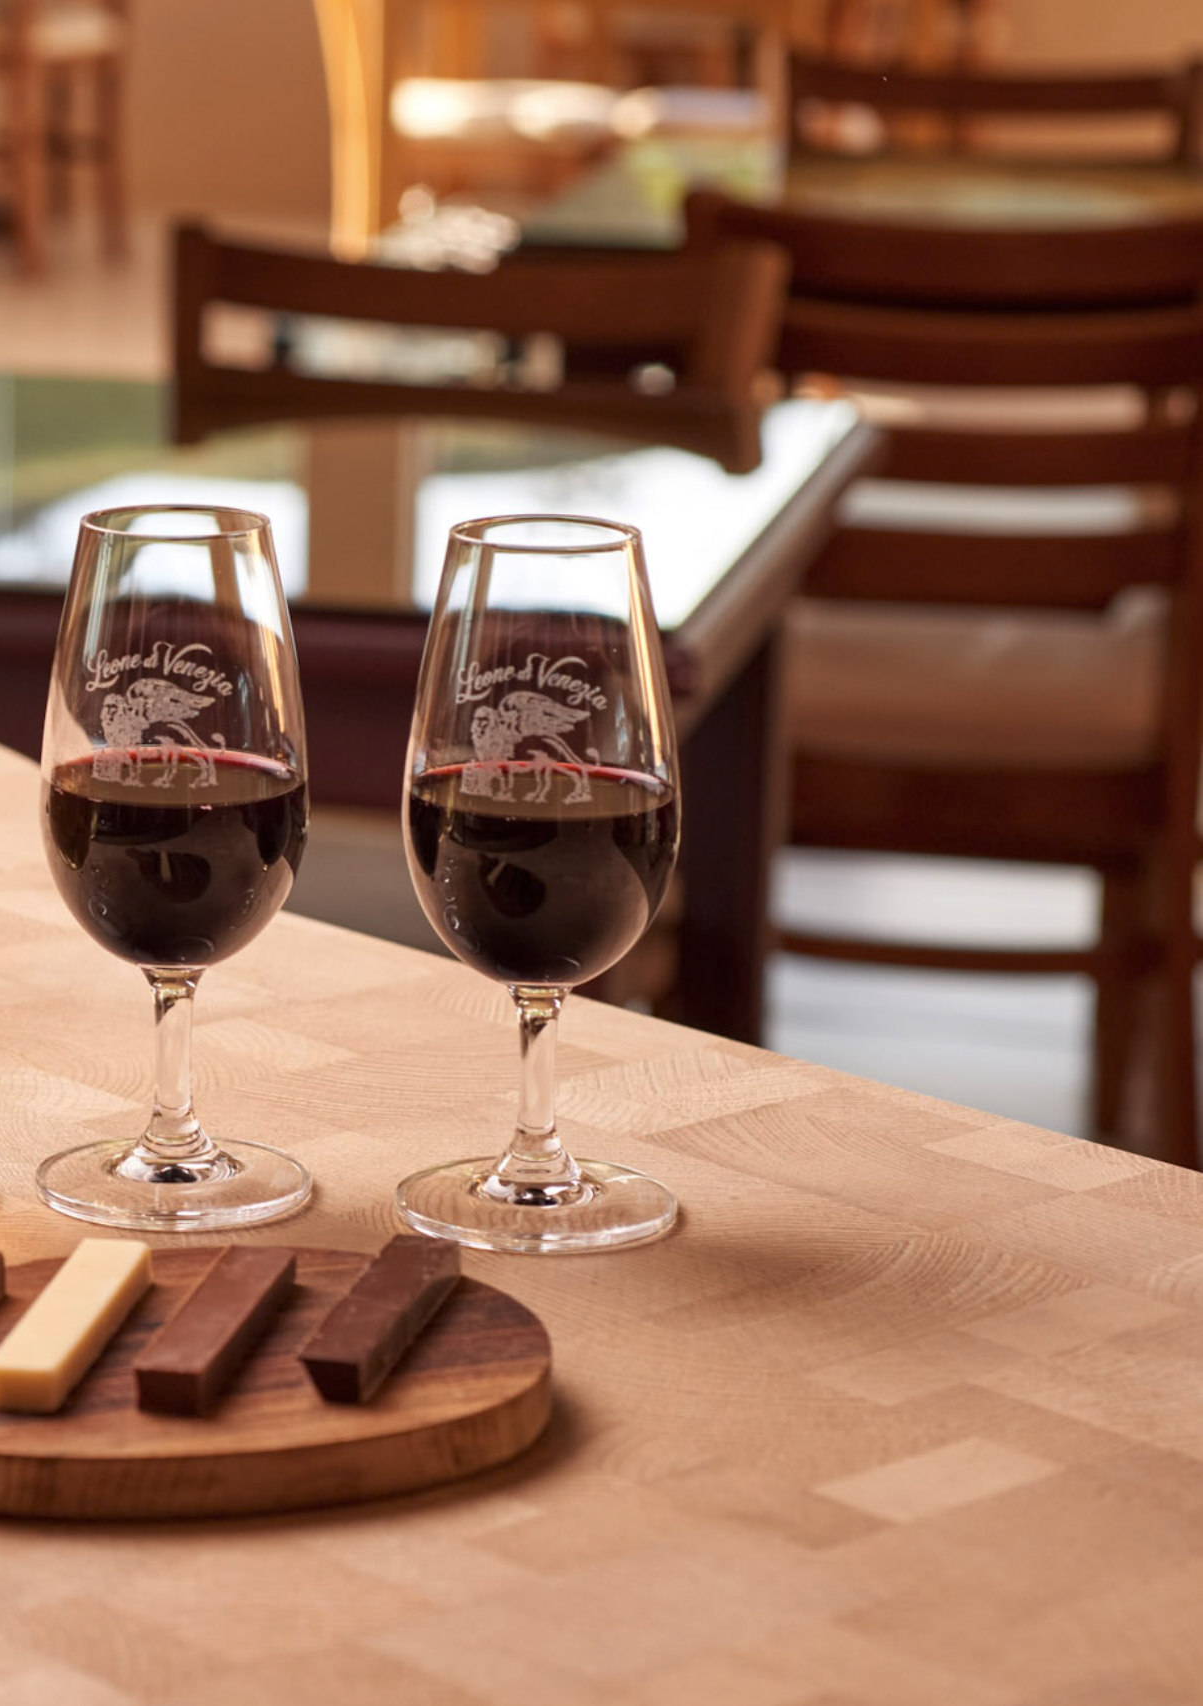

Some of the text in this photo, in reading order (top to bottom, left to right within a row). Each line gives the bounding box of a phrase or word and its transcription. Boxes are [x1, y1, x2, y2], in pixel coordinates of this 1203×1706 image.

[85, 649, 141, 692] Leone
[159, 642, 234, 696] Venezia
[455, 661, 515, 704] Leone
[534, 654, 608, 710] Venezia
